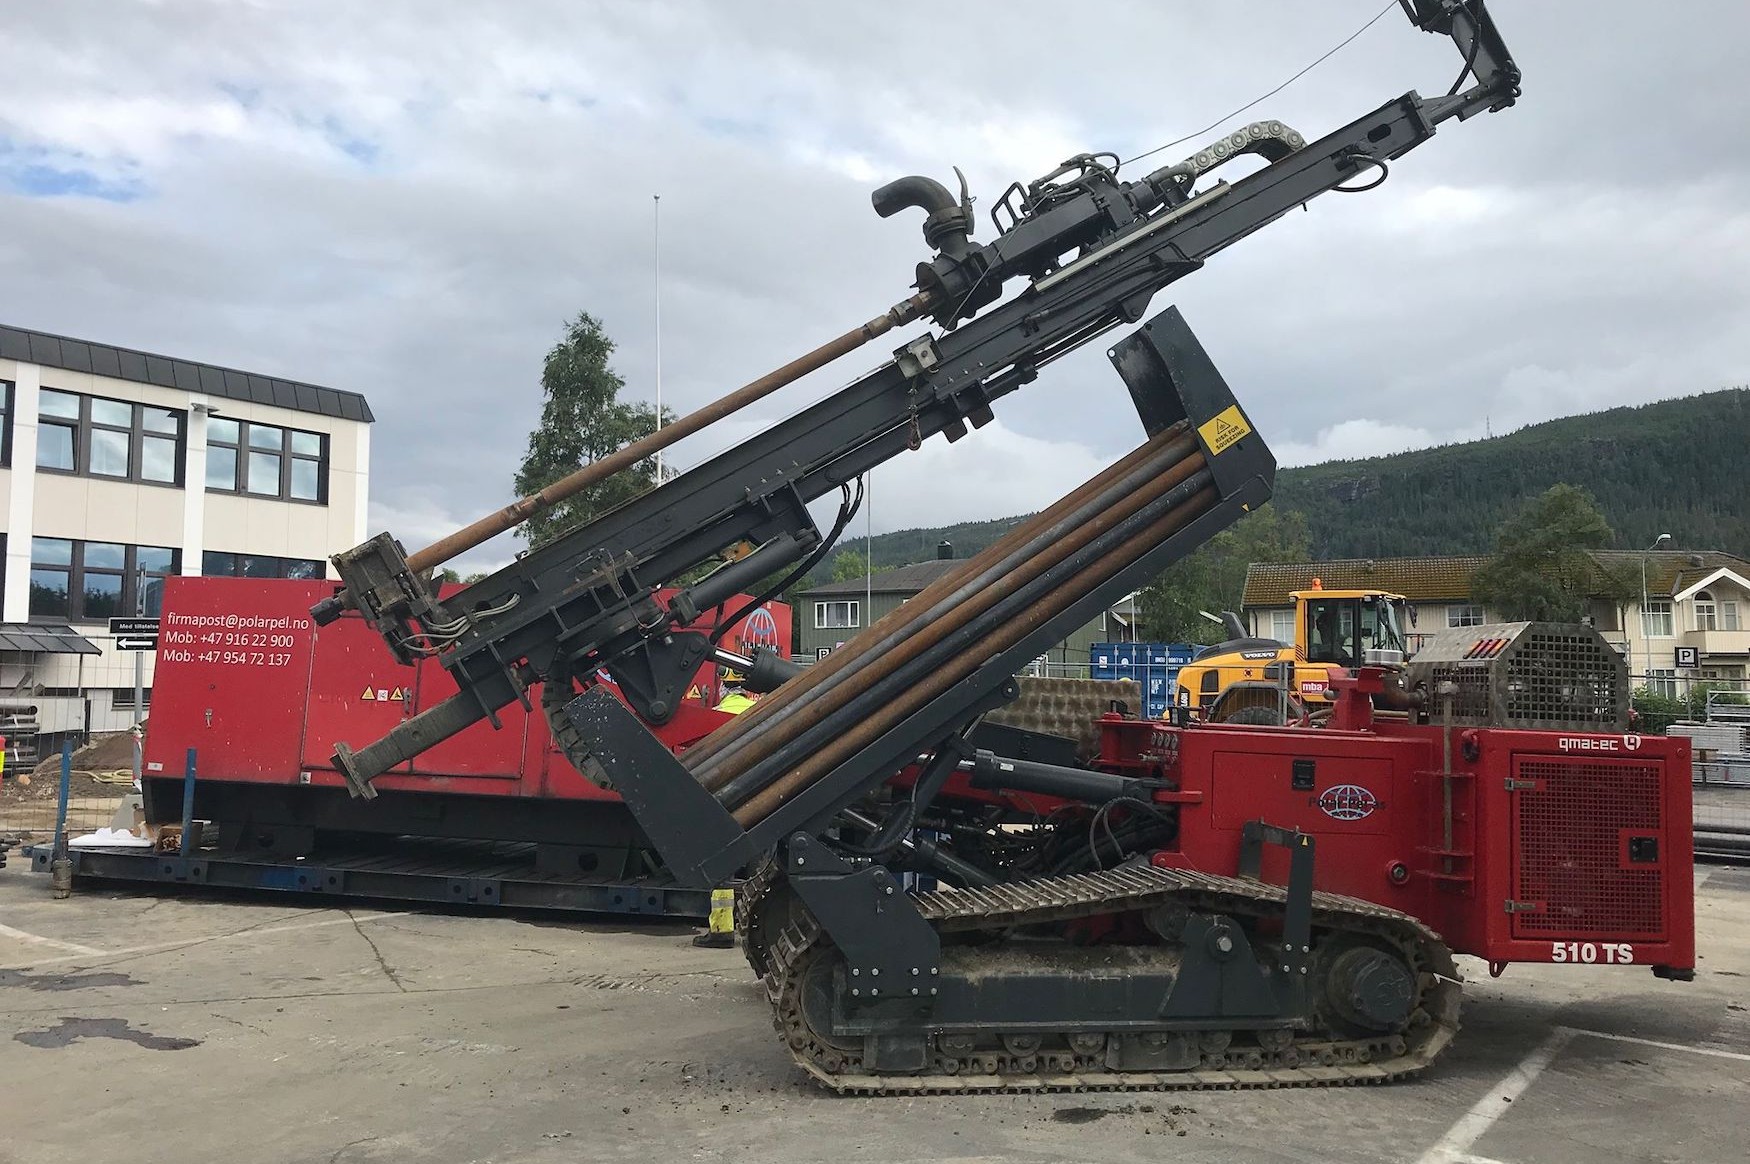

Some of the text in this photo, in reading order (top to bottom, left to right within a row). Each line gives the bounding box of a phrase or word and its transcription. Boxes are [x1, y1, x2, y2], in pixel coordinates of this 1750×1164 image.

[1227, 425, 1239, 435] FOR
[167, 611, 309, 631] firmapost@polarpel.no
[165, 630, 294, 648] Mob: +47 916 22 900
[163, 649, 291, 666] Mob: +47 954 72 137
[1244, 651, 1276, 659] VOLVO
[1681, 650, 1691, 661] P
[1302, 682, 1323, 691] mba
[1559, 738, 1619, 752] qmatec
[1552, 942, 1634, 964] 510 TS
